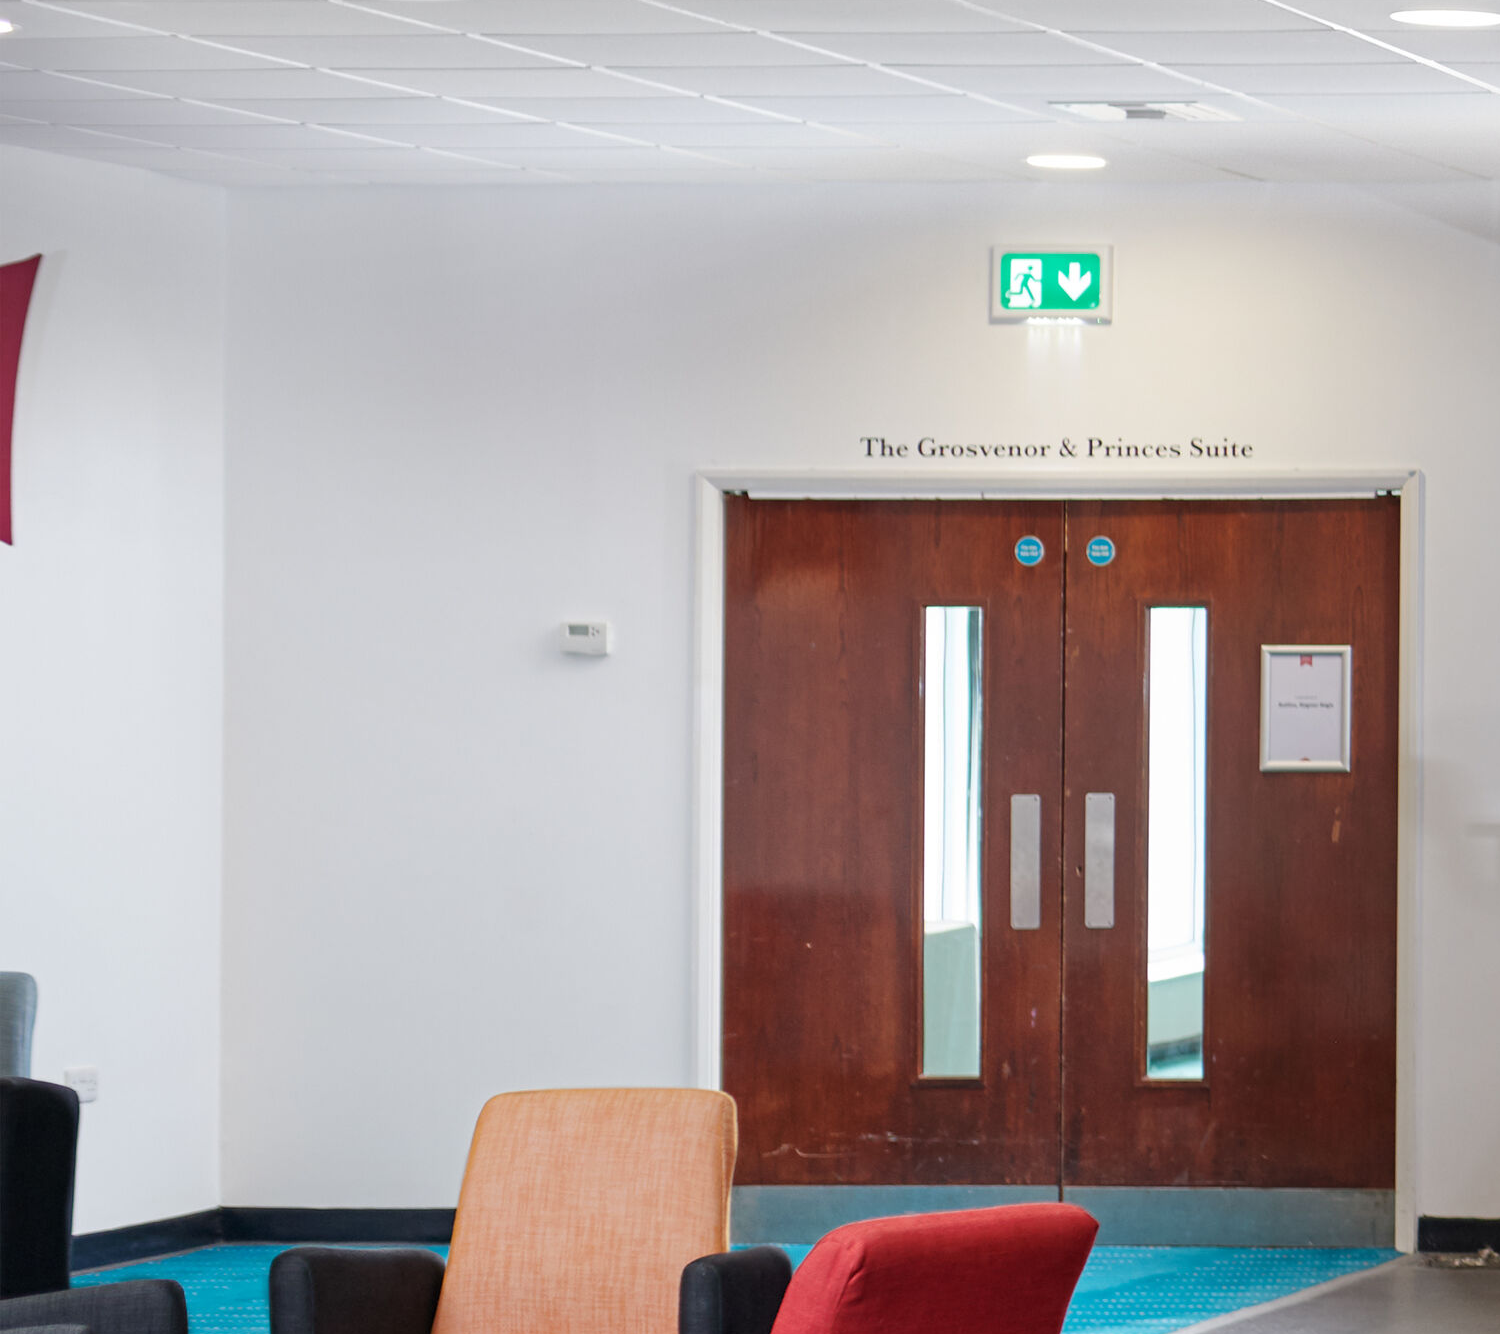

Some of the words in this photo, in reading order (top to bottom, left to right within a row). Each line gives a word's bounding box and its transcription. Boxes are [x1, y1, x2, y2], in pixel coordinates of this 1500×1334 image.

[859, 436, 909, 458] The
[916, 436, 1051, 459] Grosvenor
[1058, 436, 1078, 458] &
[1087, 436, 1182, 458] Princes
[1189, 436, 1254, 459] Suite
